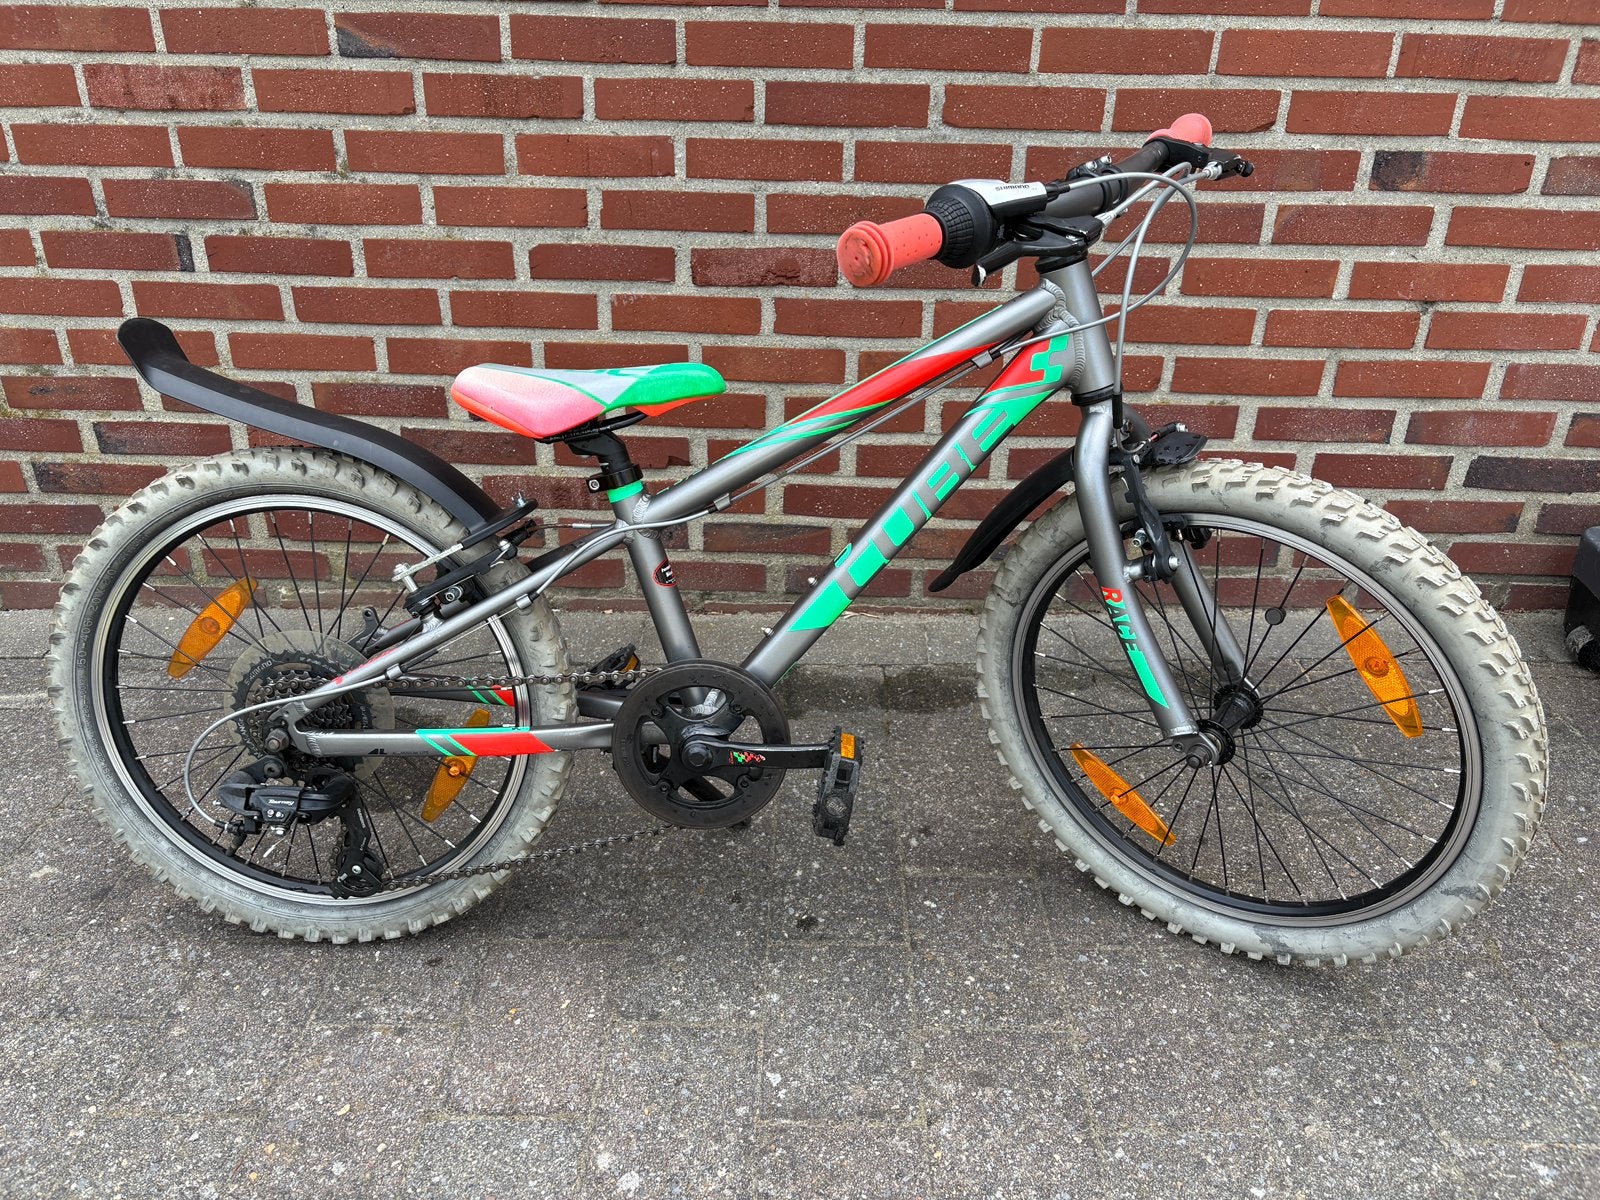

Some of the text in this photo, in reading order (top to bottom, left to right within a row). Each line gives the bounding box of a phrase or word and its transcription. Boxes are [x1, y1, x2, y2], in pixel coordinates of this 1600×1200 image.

[994, 184, 1030, 192] SHIMANO
[832, 402, 1014, 603] CUBE
[1101, 586, 1138, 653] RACE
